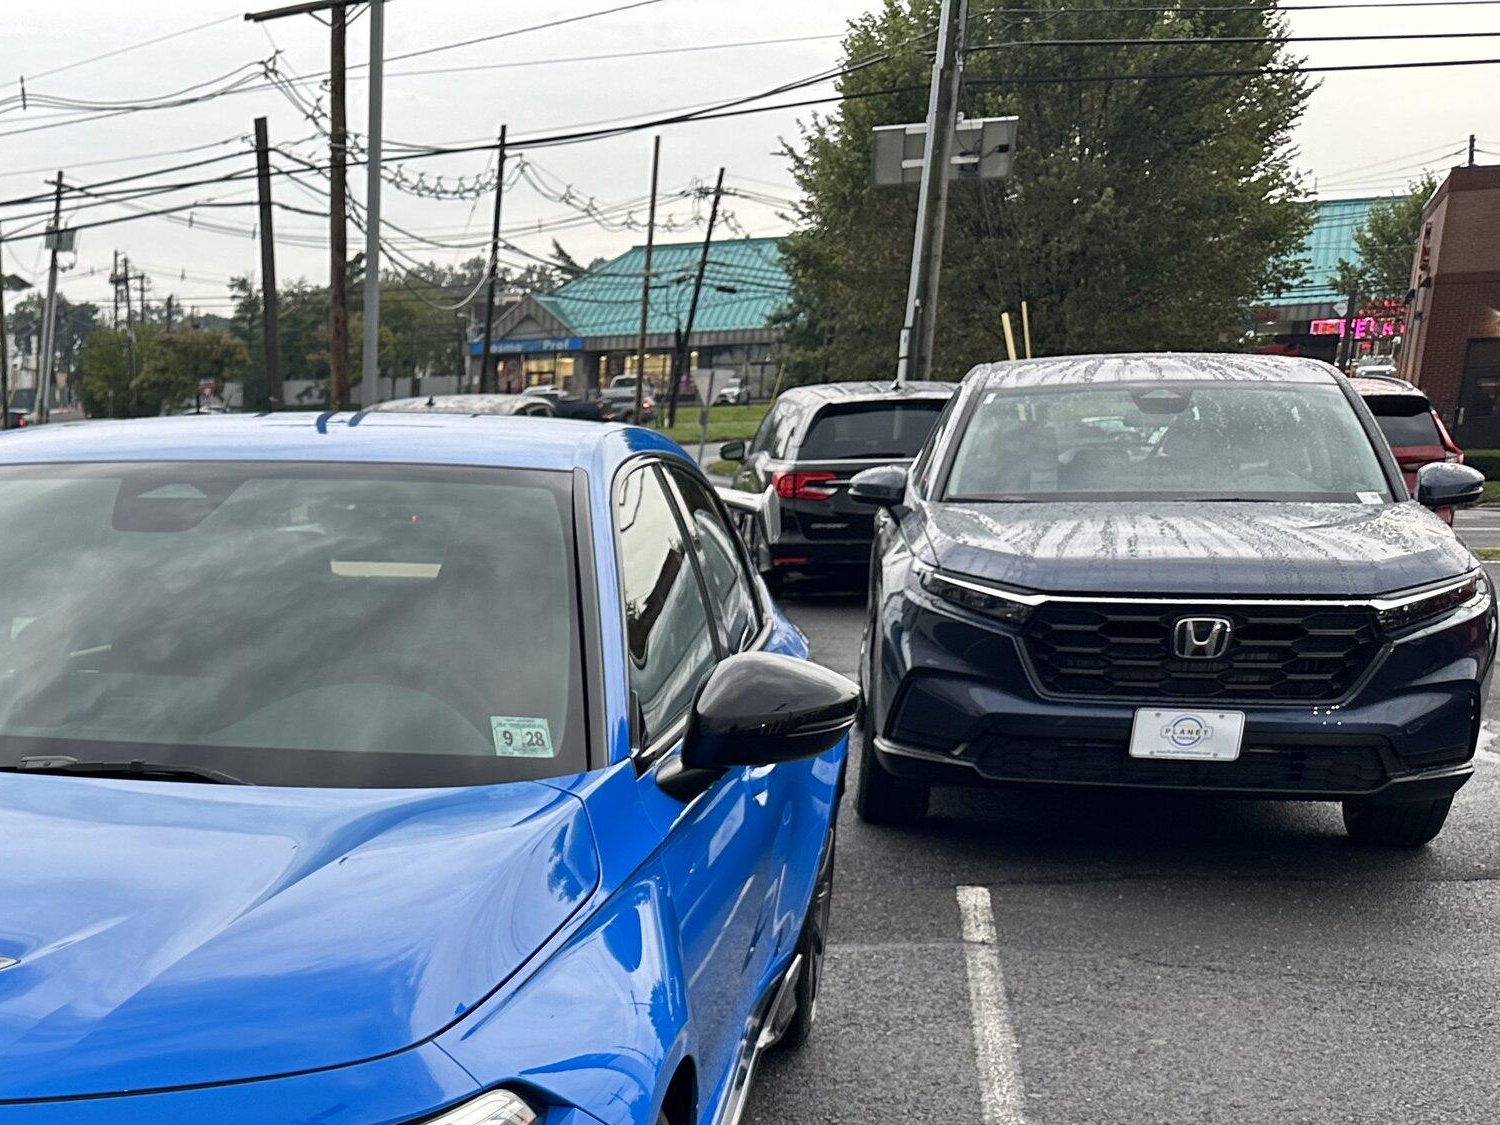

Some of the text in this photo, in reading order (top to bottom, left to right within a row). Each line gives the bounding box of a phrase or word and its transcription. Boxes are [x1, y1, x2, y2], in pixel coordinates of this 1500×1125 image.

[502, 730, 546, 747] 9 28
[1164, 728, 1209, 737] PLANET
